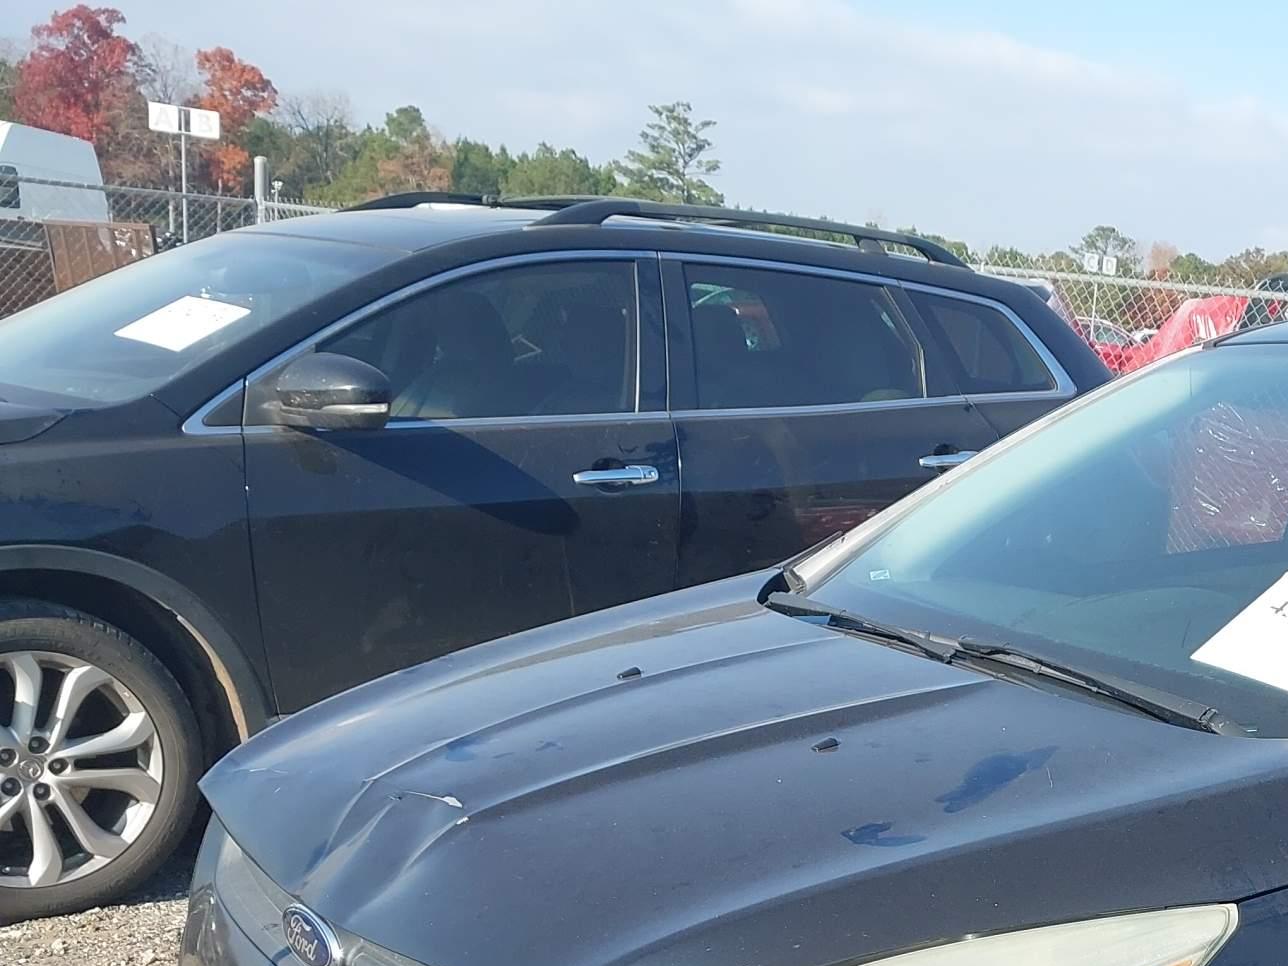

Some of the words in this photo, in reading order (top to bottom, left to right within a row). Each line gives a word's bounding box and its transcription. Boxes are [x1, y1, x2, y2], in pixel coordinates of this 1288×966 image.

[153, 106, 174, 129] A
[197, 112, 213, 132] B
[287, 914, 318, 961] Ford
